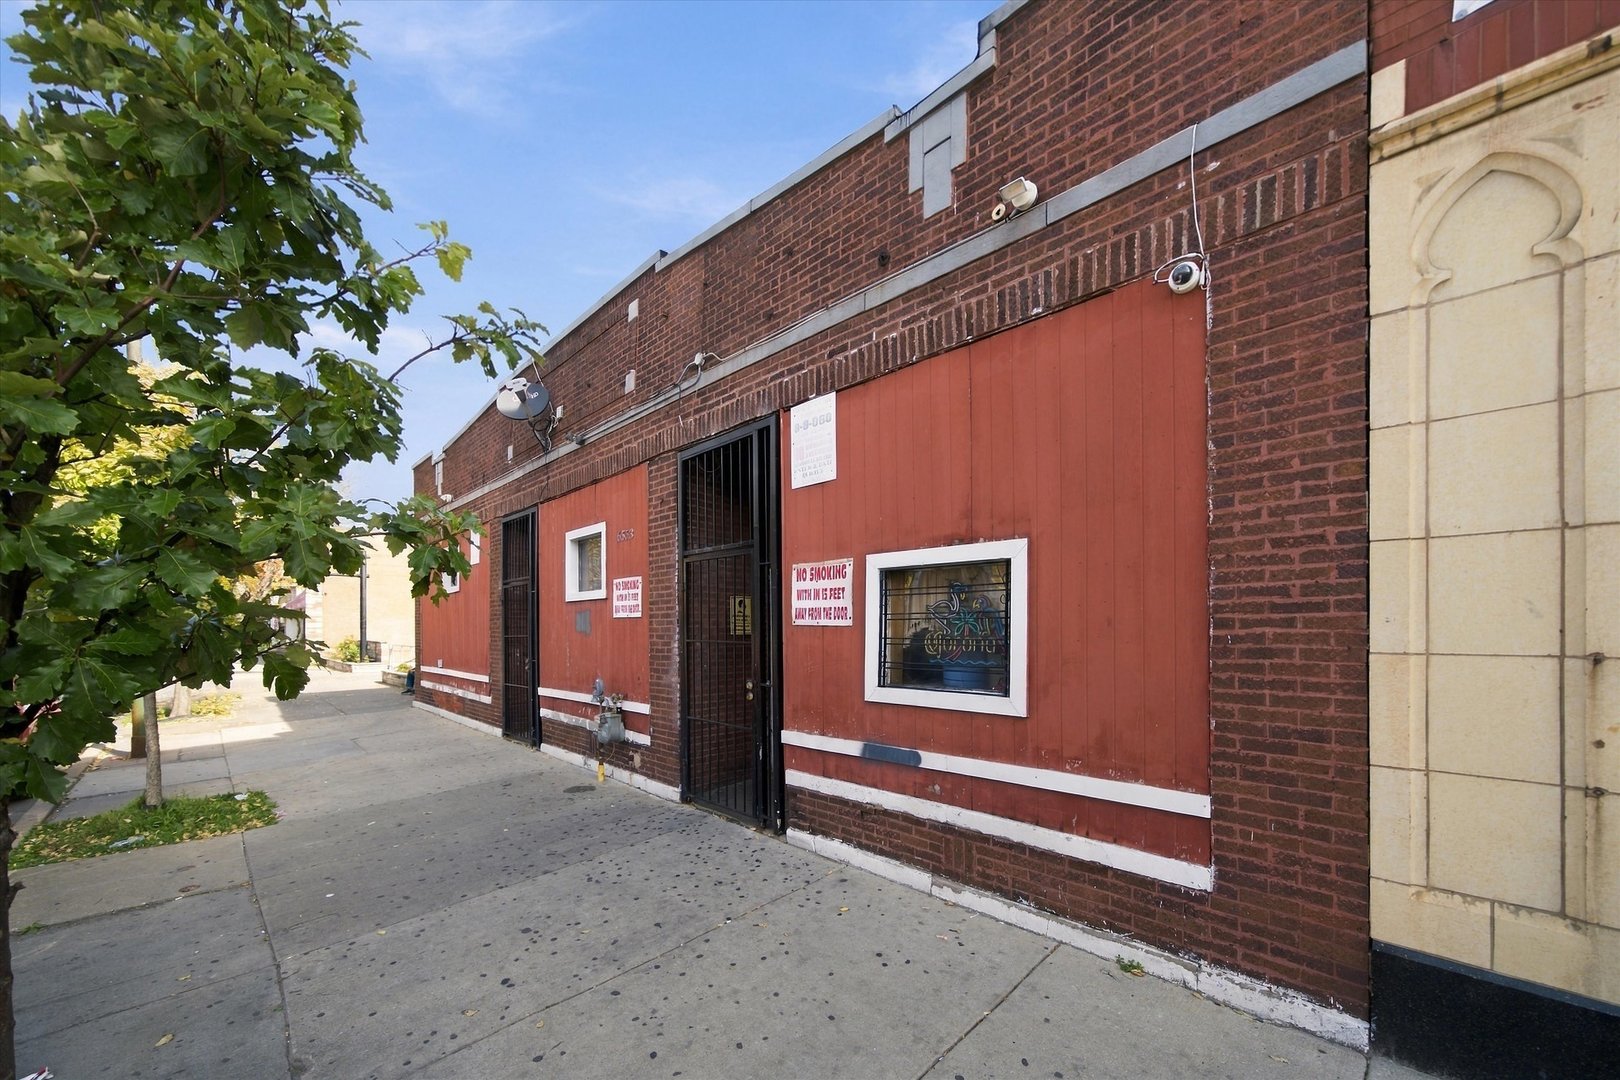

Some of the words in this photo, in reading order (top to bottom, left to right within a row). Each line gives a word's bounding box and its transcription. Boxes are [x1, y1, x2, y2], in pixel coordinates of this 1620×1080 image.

[796, 567, 807, 582] NO
[809, 564, 847, 582] SMOKING
[615, 581, 621, 591] NO
[621, 580, 639, 591] SMOKING
[796, 588, 812, 600] WITH
[813, 588, 820, 600] IN
[821, 587, 828, 600] 15
[829, 587, 845, 600] FEET
[795, 607, 807, 620] AWAY
[807, 607, 822, 620] FROM
[823, 606, 832, 620] THE
[924, 631, 996, 658] Corona
